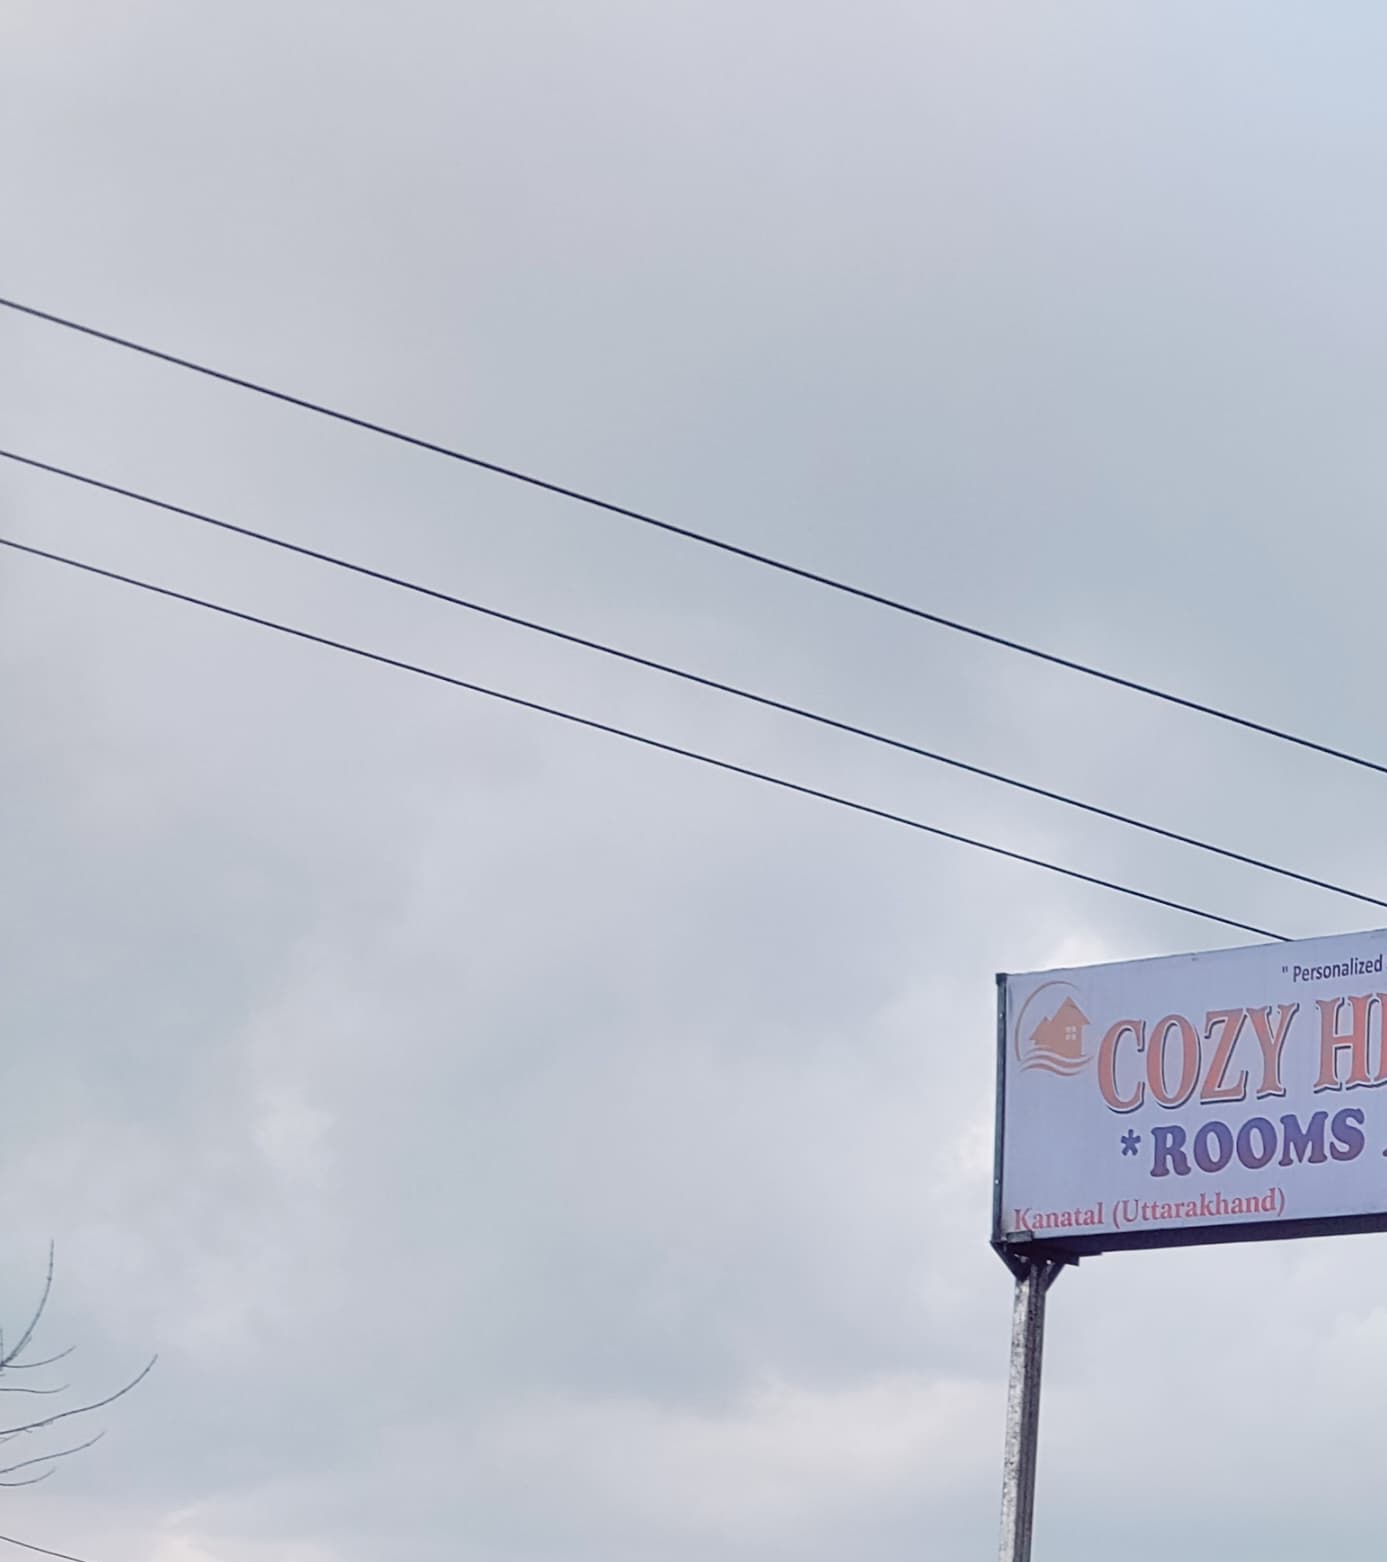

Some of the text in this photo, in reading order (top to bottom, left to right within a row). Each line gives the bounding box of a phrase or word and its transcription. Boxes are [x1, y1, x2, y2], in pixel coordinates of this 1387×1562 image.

[1293, 954, 1383, 983] Personalized
[1098, 1002, 1302, 1114] COZY
[1013, 1187, 1286, 1232] Kanatal (Uttarakhand)
